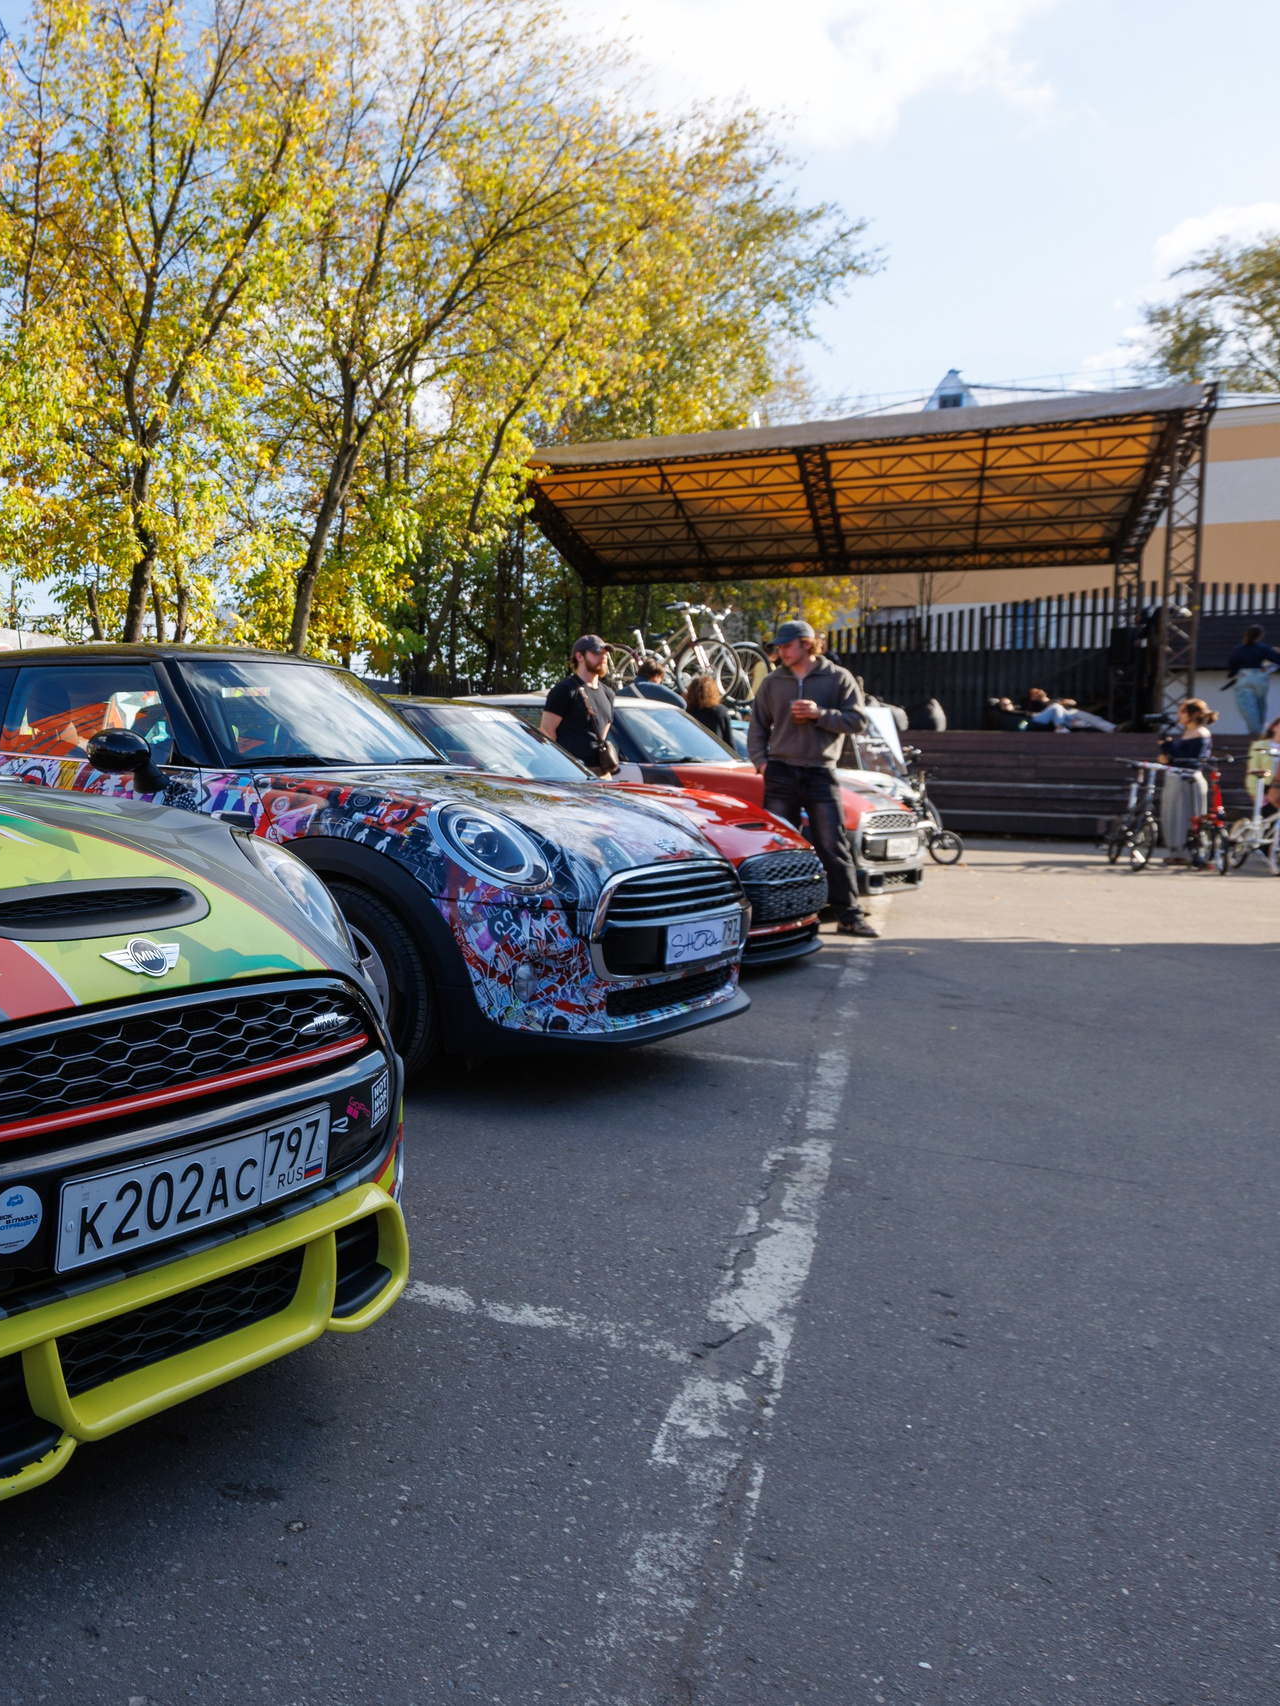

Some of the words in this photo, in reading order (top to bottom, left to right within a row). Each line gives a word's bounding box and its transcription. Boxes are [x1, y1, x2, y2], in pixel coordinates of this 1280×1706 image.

[135, 949, 163, 962] MINI
[374, 1076, 387, 1099] NOT
[349, 1096, 371, 1118] GoPro
[269, 1118, 320, 1176] 797
[277, 1166, 304, 1190] RUS
